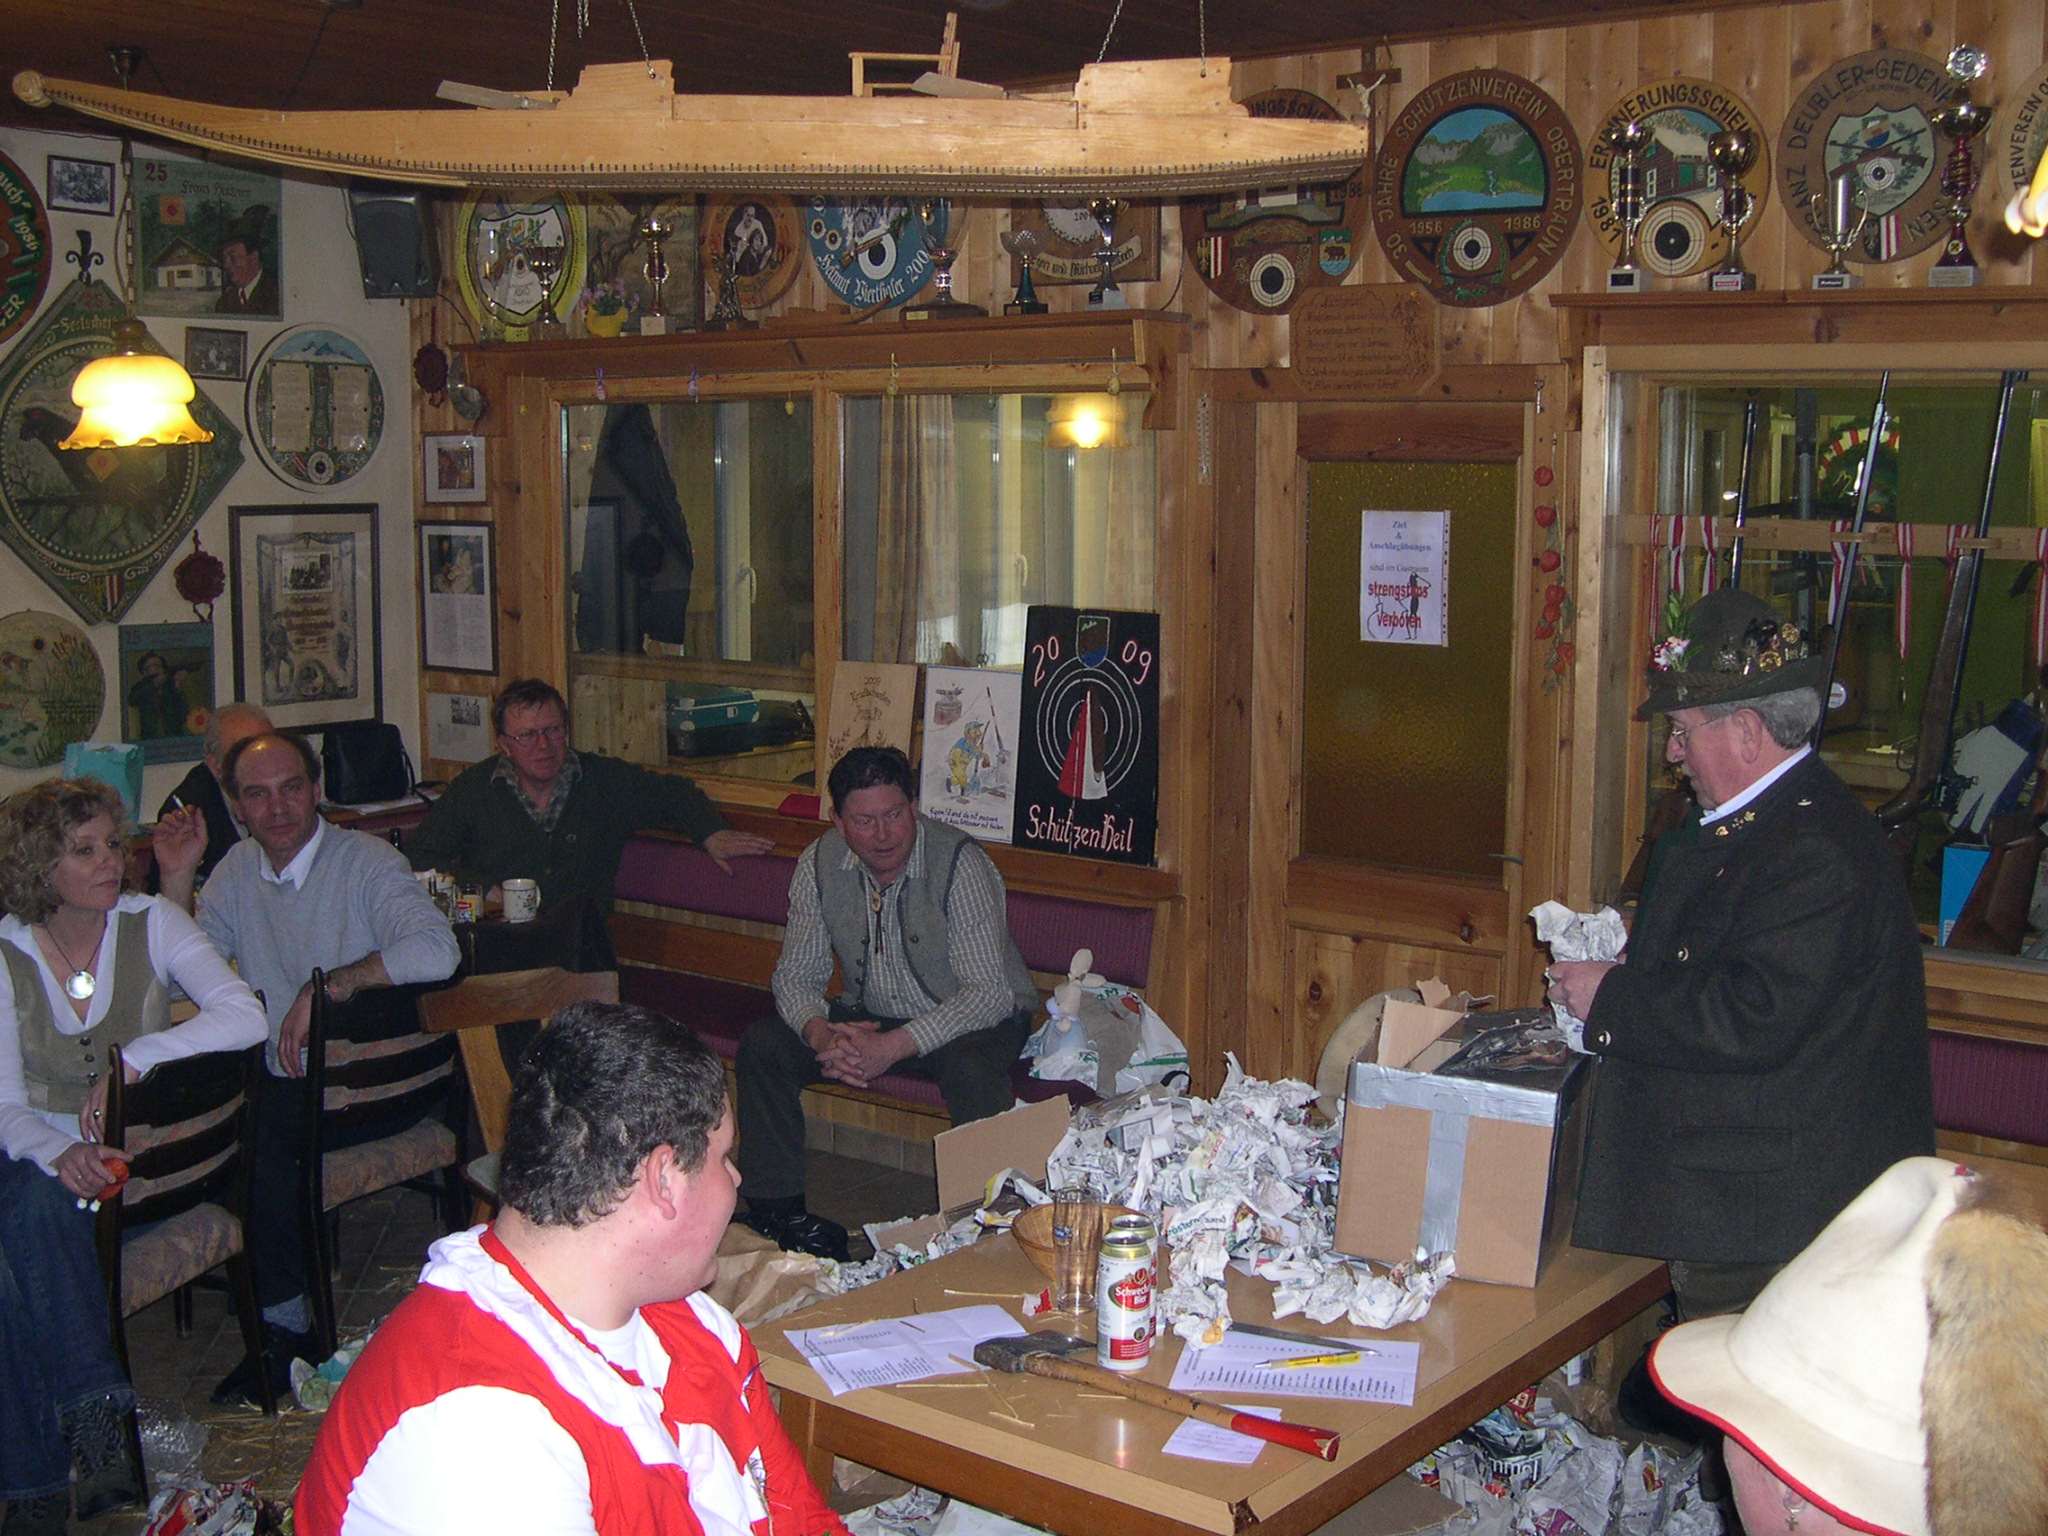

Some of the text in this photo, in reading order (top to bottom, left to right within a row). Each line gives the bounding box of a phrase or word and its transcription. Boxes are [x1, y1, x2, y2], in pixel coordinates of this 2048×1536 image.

[1376, 153, 1399, 224] JAHRE
[1537, 126, 1575, 257] OBERTRAUN
[1504, 214, 1542, 230] 1986
[1133, 1294, 1148, 1304] Bier
